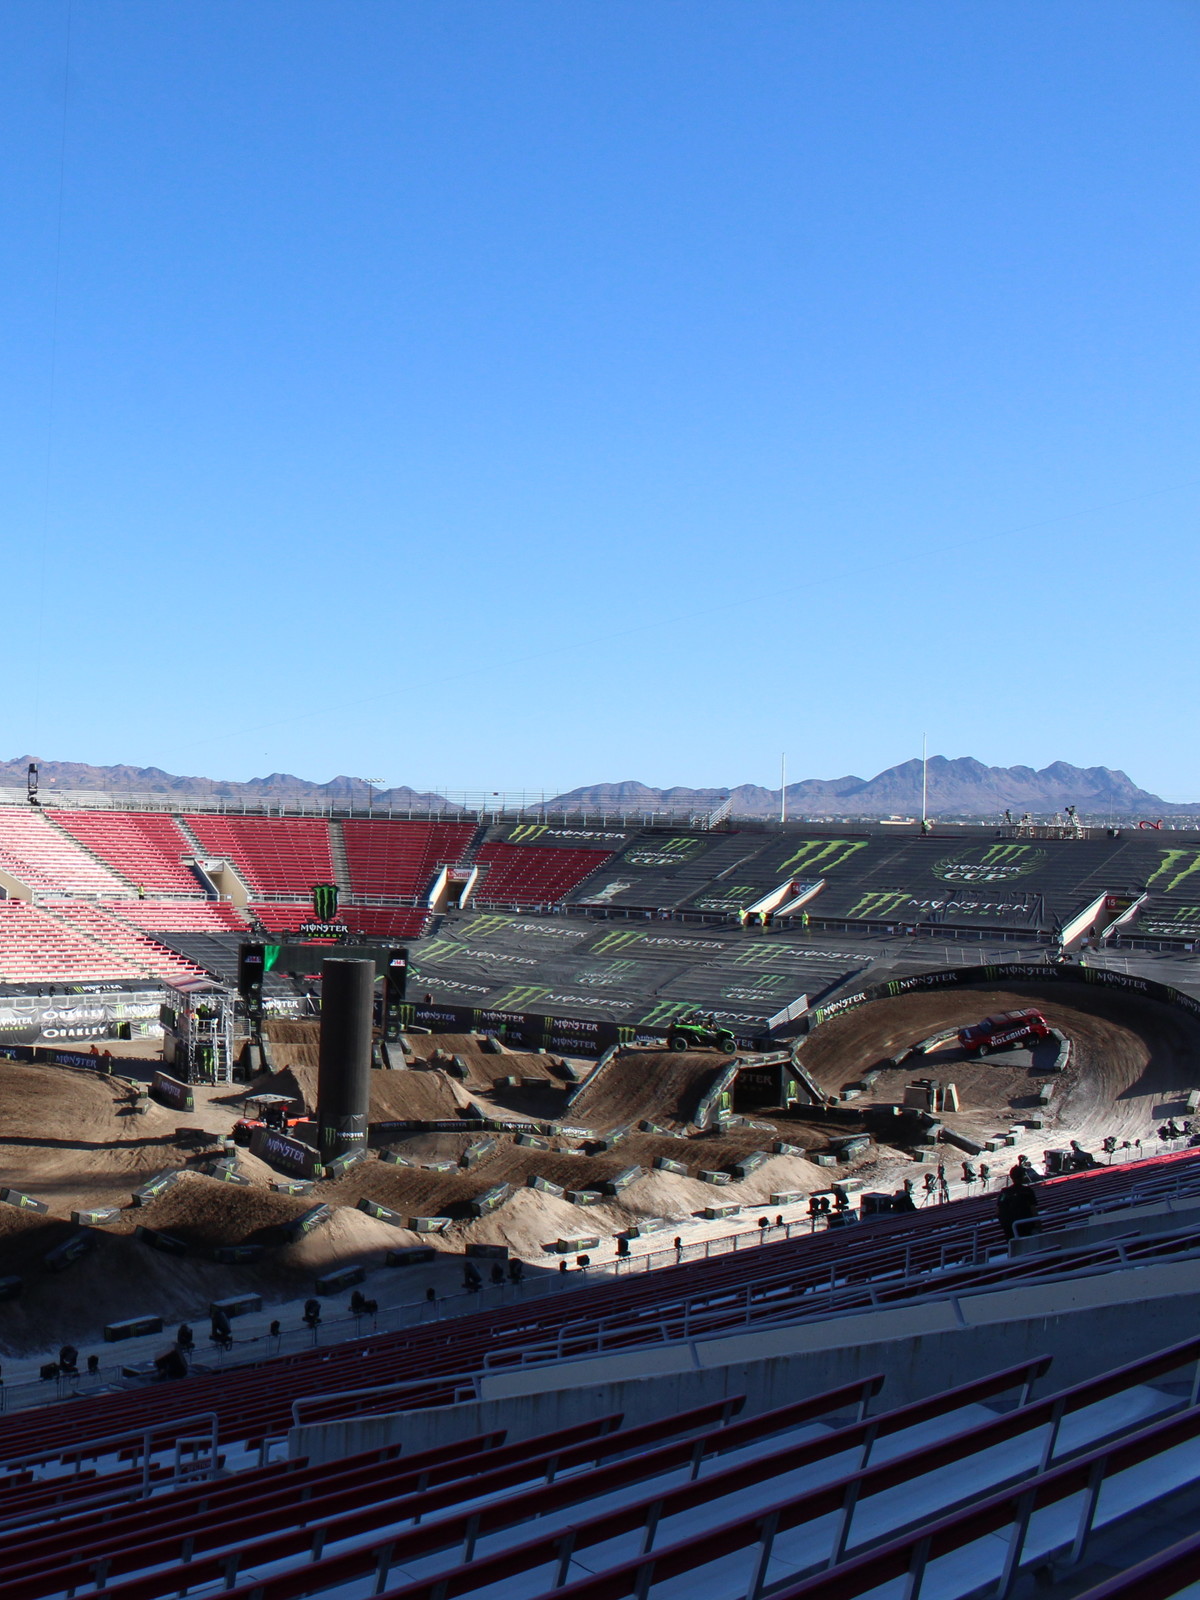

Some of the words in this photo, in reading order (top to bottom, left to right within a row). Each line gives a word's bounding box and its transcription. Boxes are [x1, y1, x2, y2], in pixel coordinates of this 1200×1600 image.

[547, 829, 626, 839] MONSTER
[945, 864, 1022, 872] MONSTER
[944, 872, 1007, 880] CUP
[908, 899, 1029, 912] MONSTER
[301, 924, 349, 933] MONSTER
[509, 922, 588, 938] MONSTER
[641, 937, 726, 948] MONSTER
[463, 949, 540, 965] MONSTER
[788, 949, 878, 961] MONSTER
[999, 965, 1058, 977] MONSTER
[412, 974, 492, 993] MONSTER
[900, 972, 958, 989] MONSTER
[1098, 972, 1147, 991] MONSTER
[546, 993, 635, 1009] MONSTER
[824, 992, 867, 1016] MONSTER
[416, 1011, 456, 1021] MONSTER
[482, 1012, 525, 1023] MONSTER
[554, 1019, 599, 1031] MONSTER
[60, 1027, 106, 1037] OAKLEY
[991, 1025, 1031, 1047] HOLESHOT
[552, 1037, 598, 1049] MONSTER
[55, 1054, 97, 1068] MONSTER
[266, 1138, 305, 1165] MONSTER
